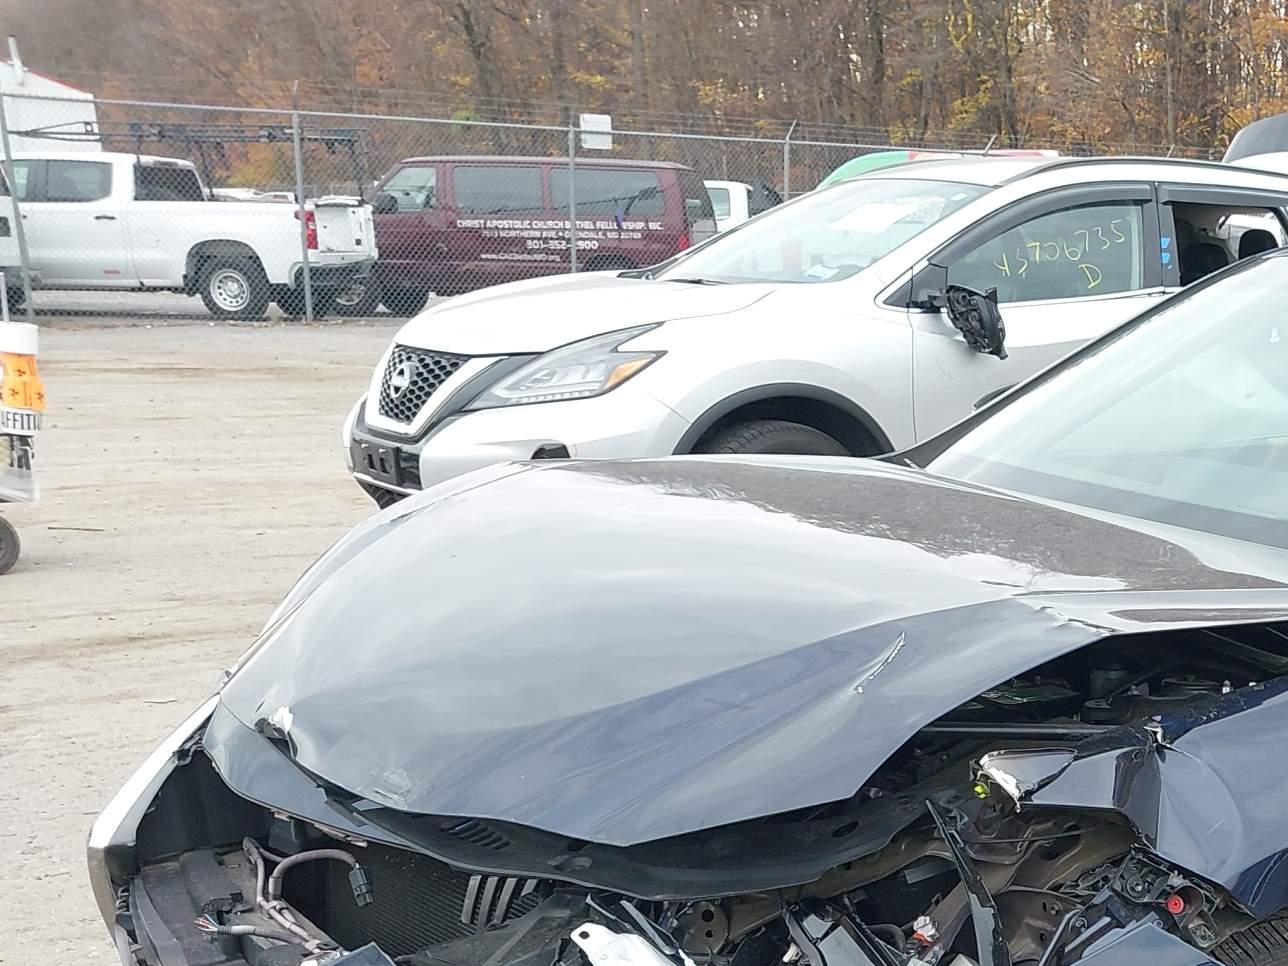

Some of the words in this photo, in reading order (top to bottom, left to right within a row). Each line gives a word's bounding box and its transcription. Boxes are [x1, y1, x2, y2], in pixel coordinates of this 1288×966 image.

[457, 219, 485, 229] CHRIST
[486, 219, 531, 229] APOSTOLIC
[532, 220, 563, 229] CHURCH
[564, 220, 595, 230] BTHEL
[526, 239, 599, 250] 301-352-900
[1078, 263, 1102, 289] D
